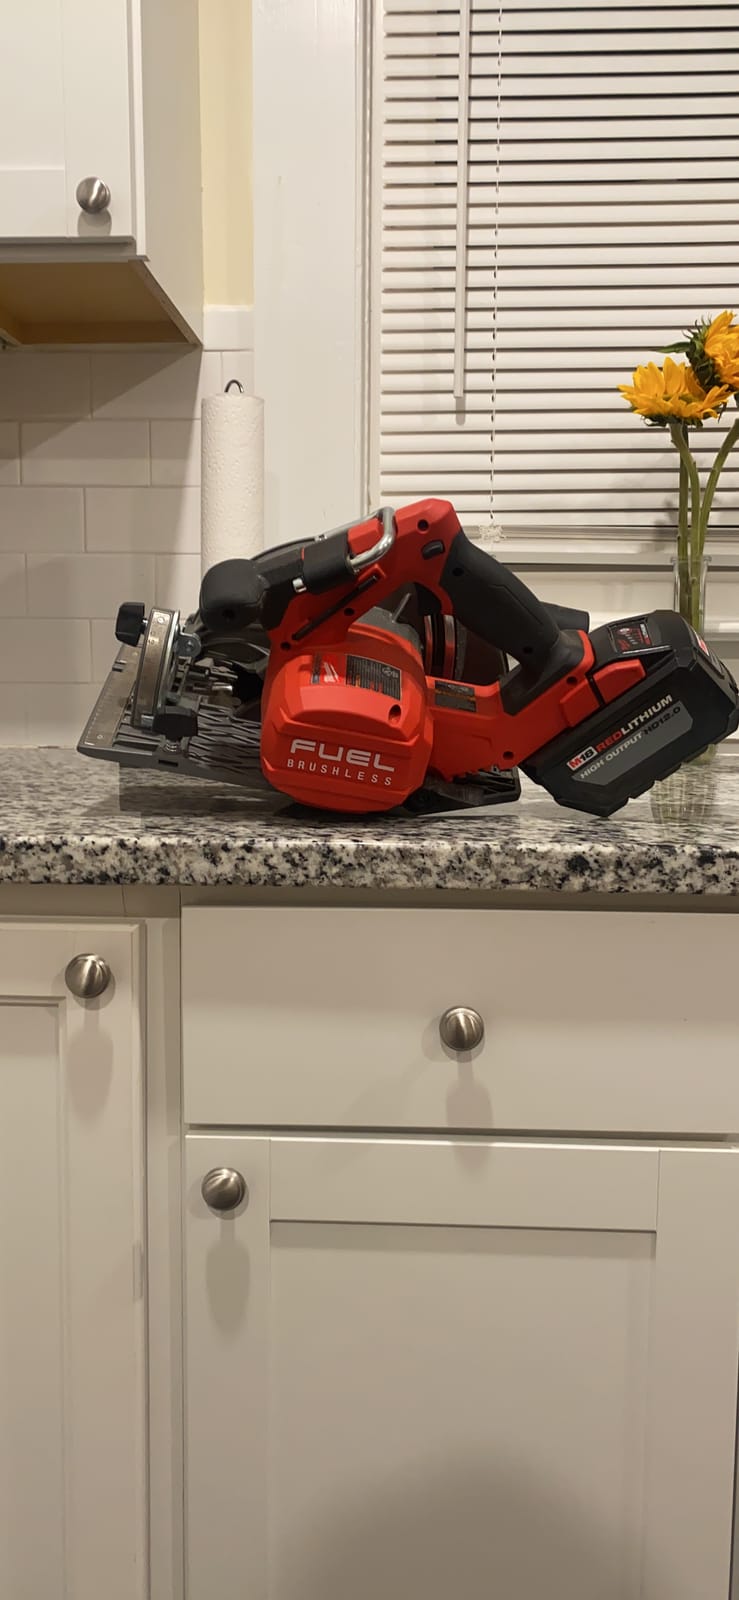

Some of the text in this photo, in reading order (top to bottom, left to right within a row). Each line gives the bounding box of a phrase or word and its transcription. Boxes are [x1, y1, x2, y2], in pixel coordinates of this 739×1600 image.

[290, 739, 395, 772] FUEL
[568, 748, 596, 769] M18
[580, 759, 605, 779] HIGH
[605, 732, 642, 761] OUTPUT
[287, 758, 392, 786] BRUSHLESS
